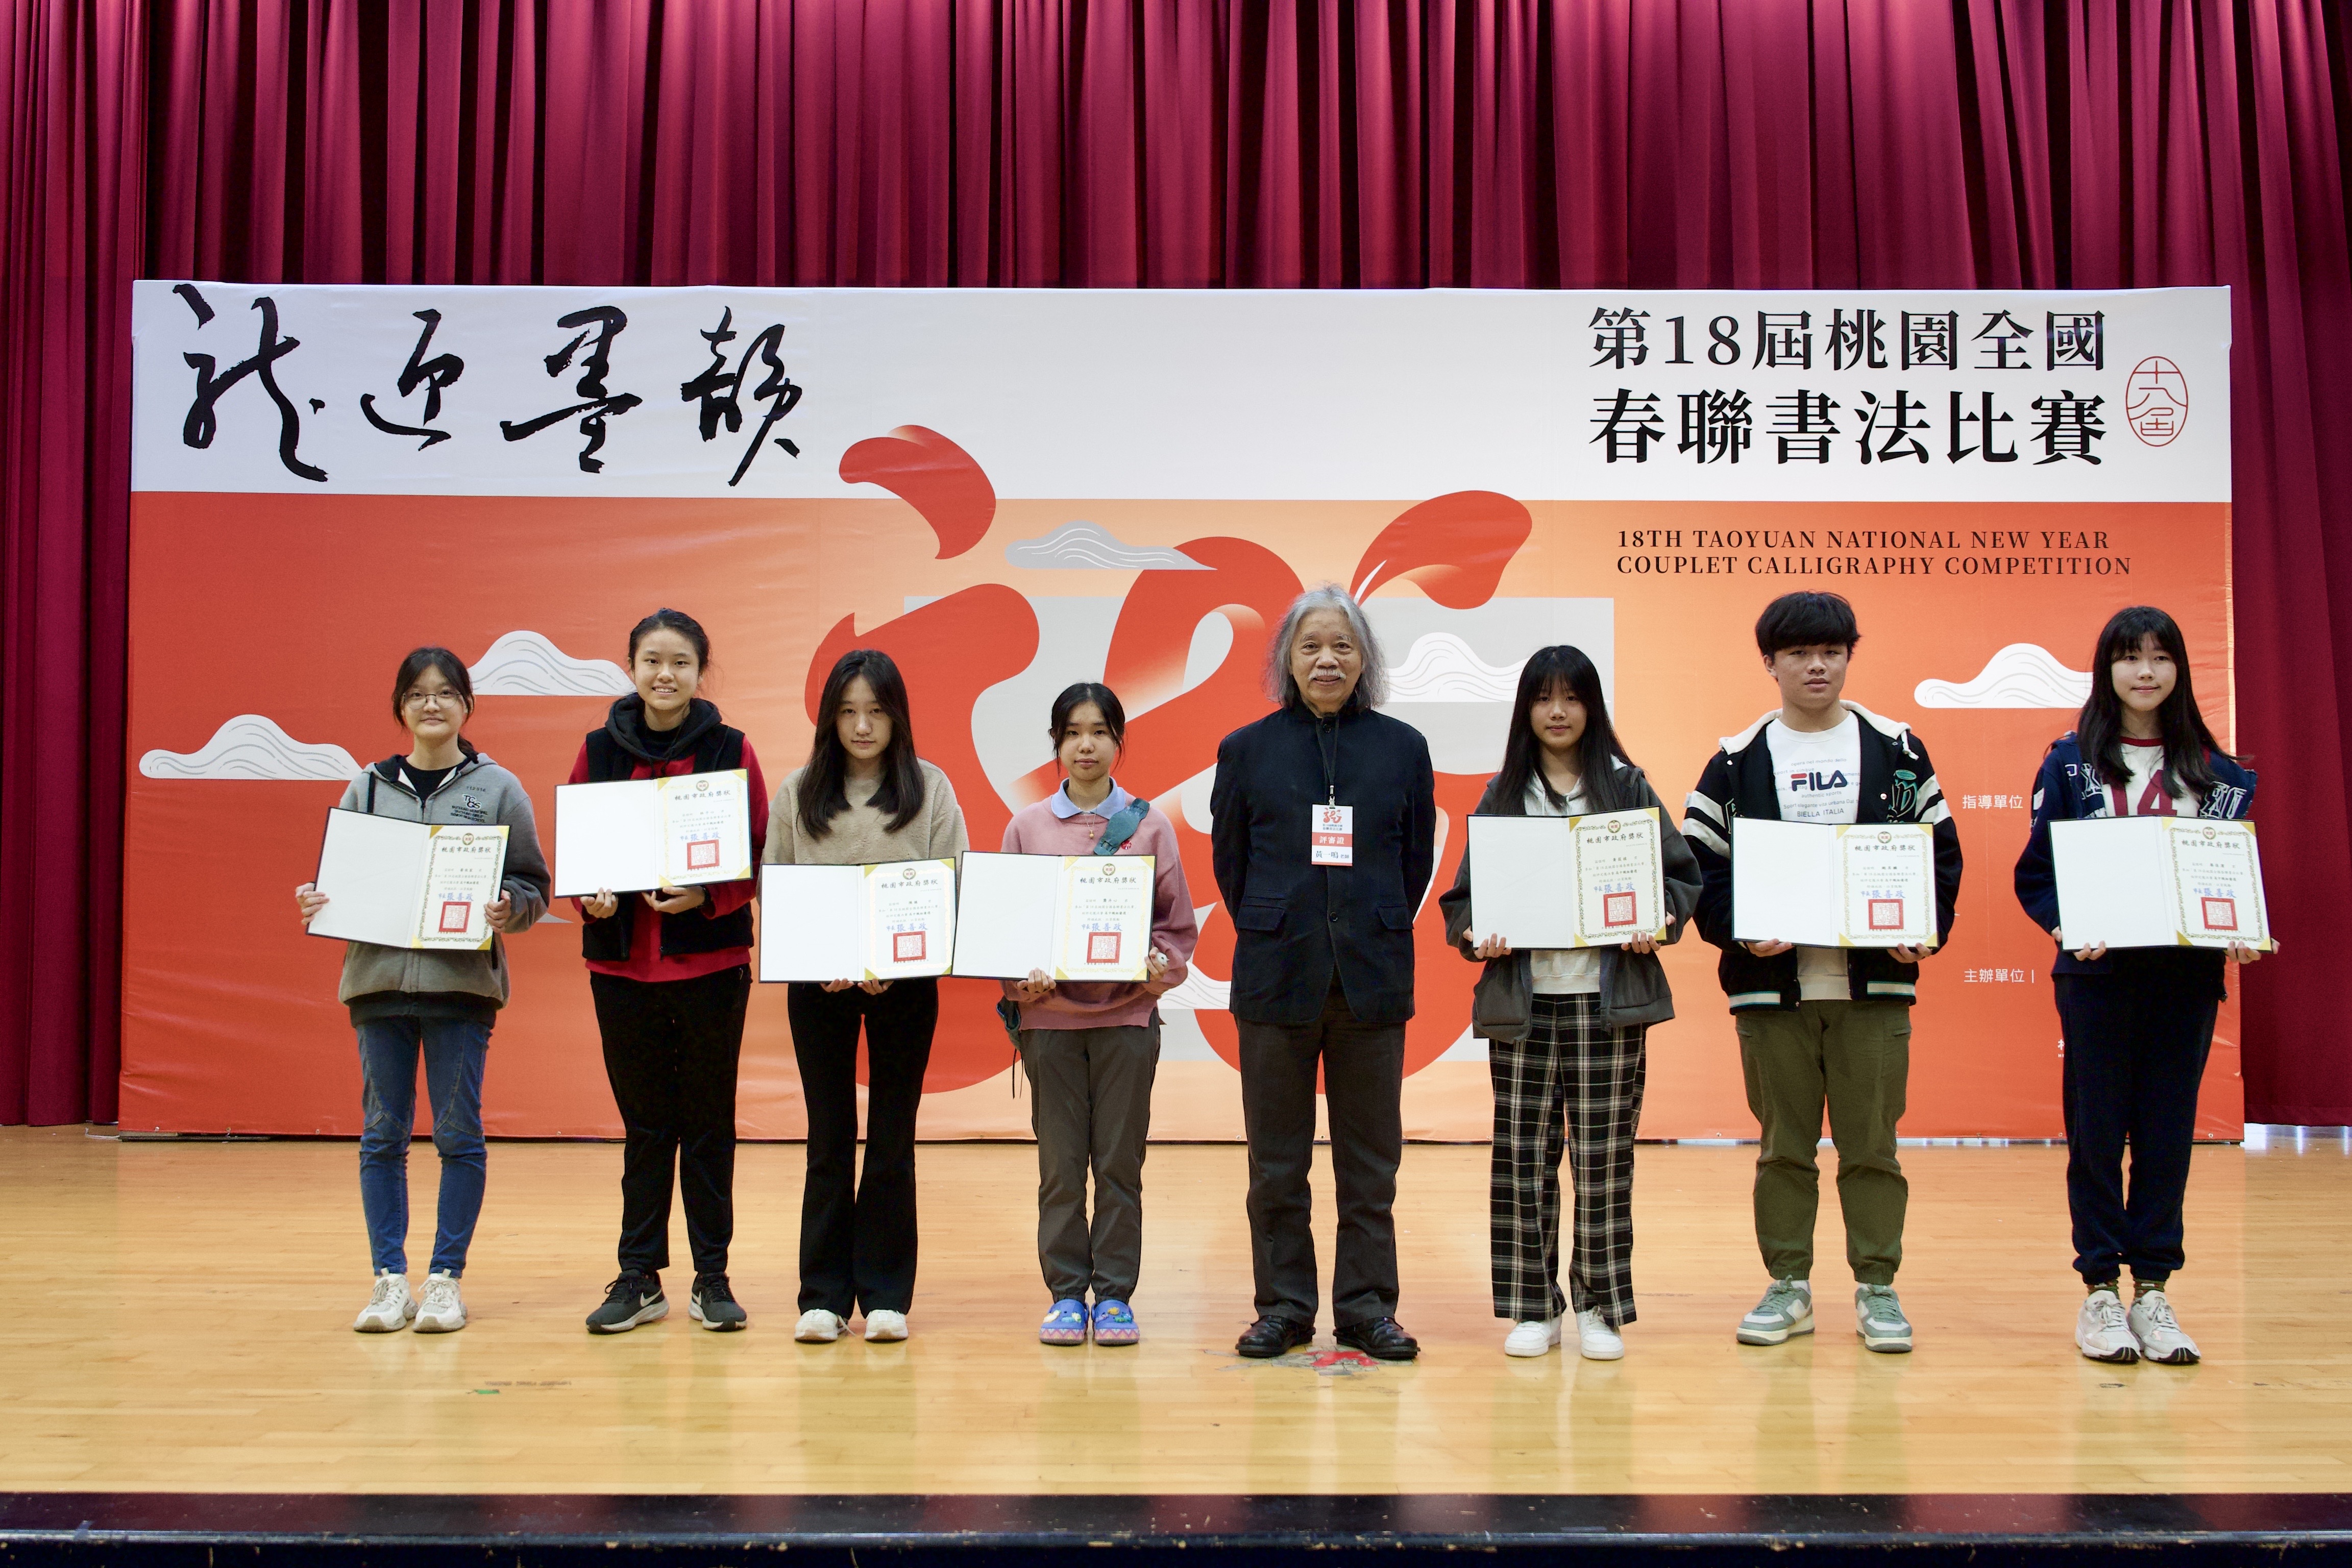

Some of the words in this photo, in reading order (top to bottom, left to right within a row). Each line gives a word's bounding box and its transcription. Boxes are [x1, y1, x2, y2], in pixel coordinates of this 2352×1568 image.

[1588, 307, 2105, 371] 第18屆桃園全國
[1589, 388, 2107, 465] 春聯書法比賽
[1619, 530, 1682, 548] 18TH
[1693, 530, 1816, 548] TAOYUAN
[1826, 531, 1960, 549] NATIONAL
[1971, 531, 2030, 549] NEW
[2040, 531, 2109, 549] YEAR
[1618, 556, 1737, 574] COUPLET
[1748, 556, 1934, 574] CALLIGRAPHY
[1945, 557, 2131, 575] COMPETITION
[1790, 770, 1847, 791] FILA
[674, 790, 731, 801] 桃園市政府獎狀
[1962, 795, 2023, 809] 指導單位
[1319, 836, 1345, 845] 評審證
[1586, 831, 1644, 844] 桃園市政府獎狀
[441, 846, 492, 854] 桃園市政府獎狀
[2181, 840, 2241, 849] 桃園市政府獎狀
[1315, 850, 1338, 859] 黃一鳴
[881, 879, 939, 889] 桃園市政府獎狀
[1964, 968, 2025, 983] 主辦單位
